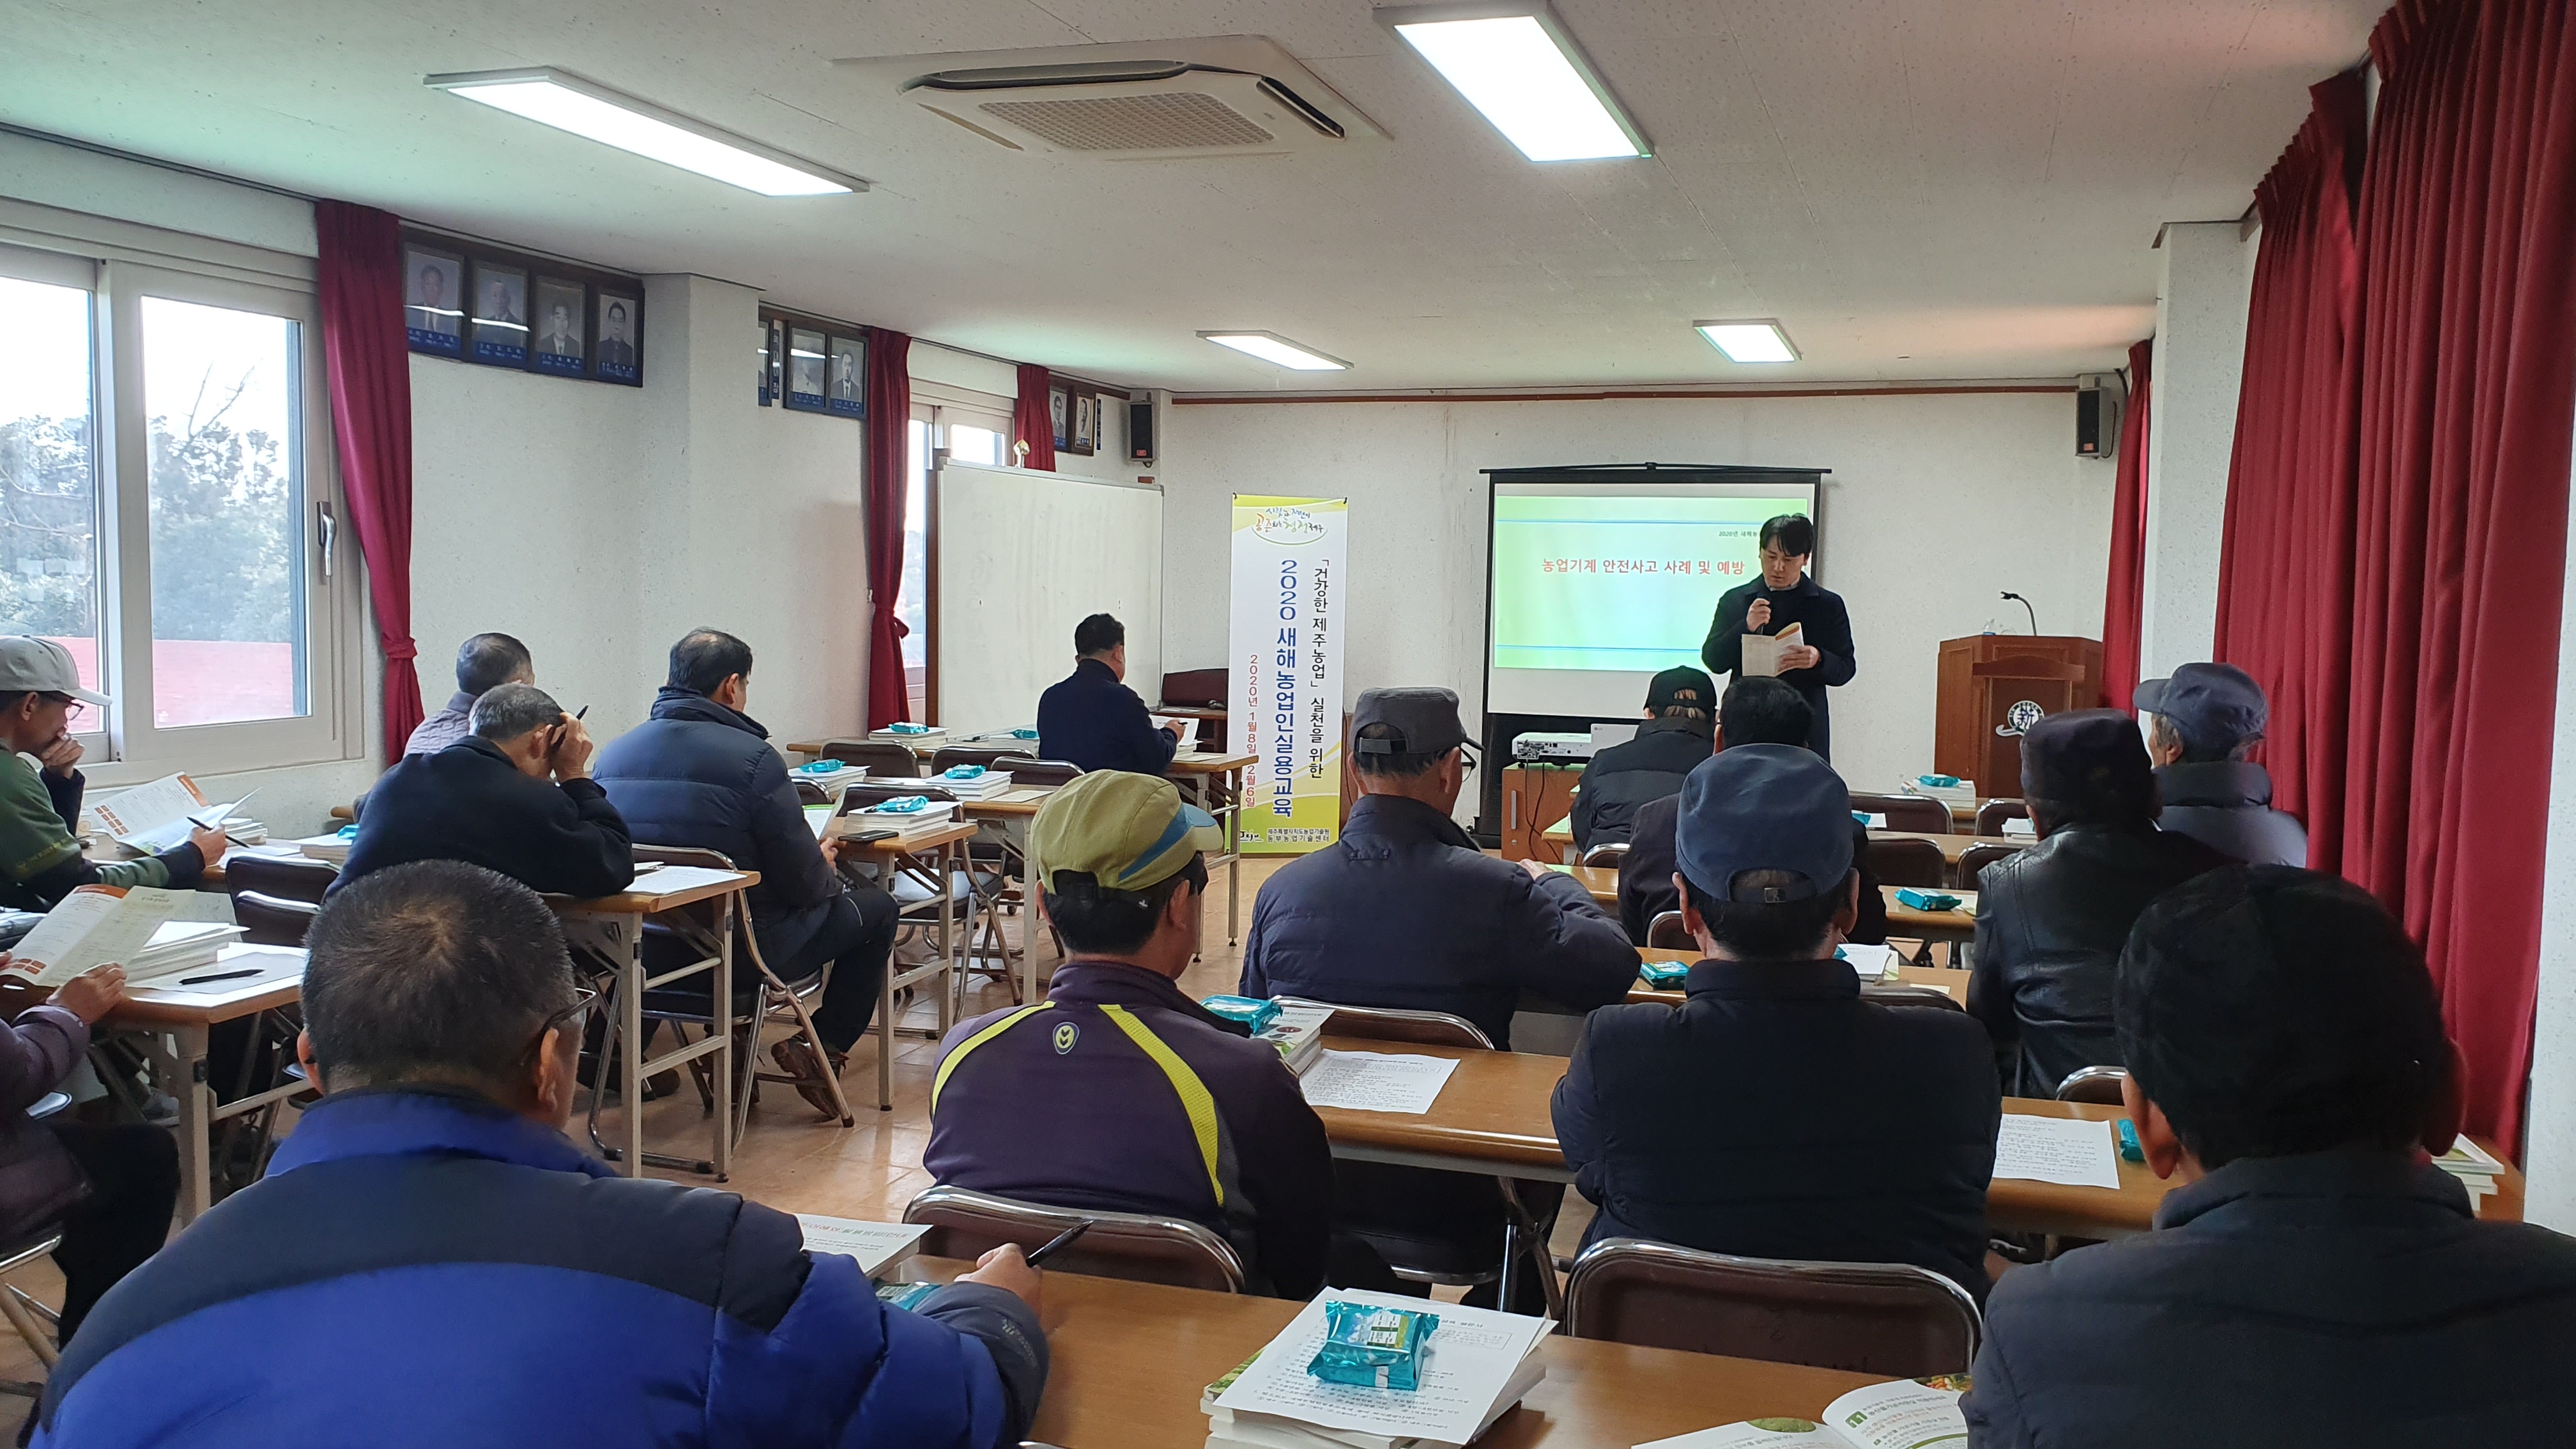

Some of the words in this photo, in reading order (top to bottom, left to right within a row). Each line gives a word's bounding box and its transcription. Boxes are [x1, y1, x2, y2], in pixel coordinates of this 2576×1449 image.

[1280, 560, 1298, 620] 2020
[1542, 558, 1597, 573] 농업기계
[1602, 559, 1658, 574] 안전사고
[1664, 560, 1692, 574] 사례
[1698, 560, 1711, 575] 및
[1717, 560, 1745, 575] 예방
[1248, 654, 1258, 707] 2020년
[1273, 627, 1296, 818] 새해농업인실용교육
[1309, 697, 1324, 744] 실천을
[1308, 747, 1324, 778] 위한
[1239, 830, 1259, 841] Jeju
